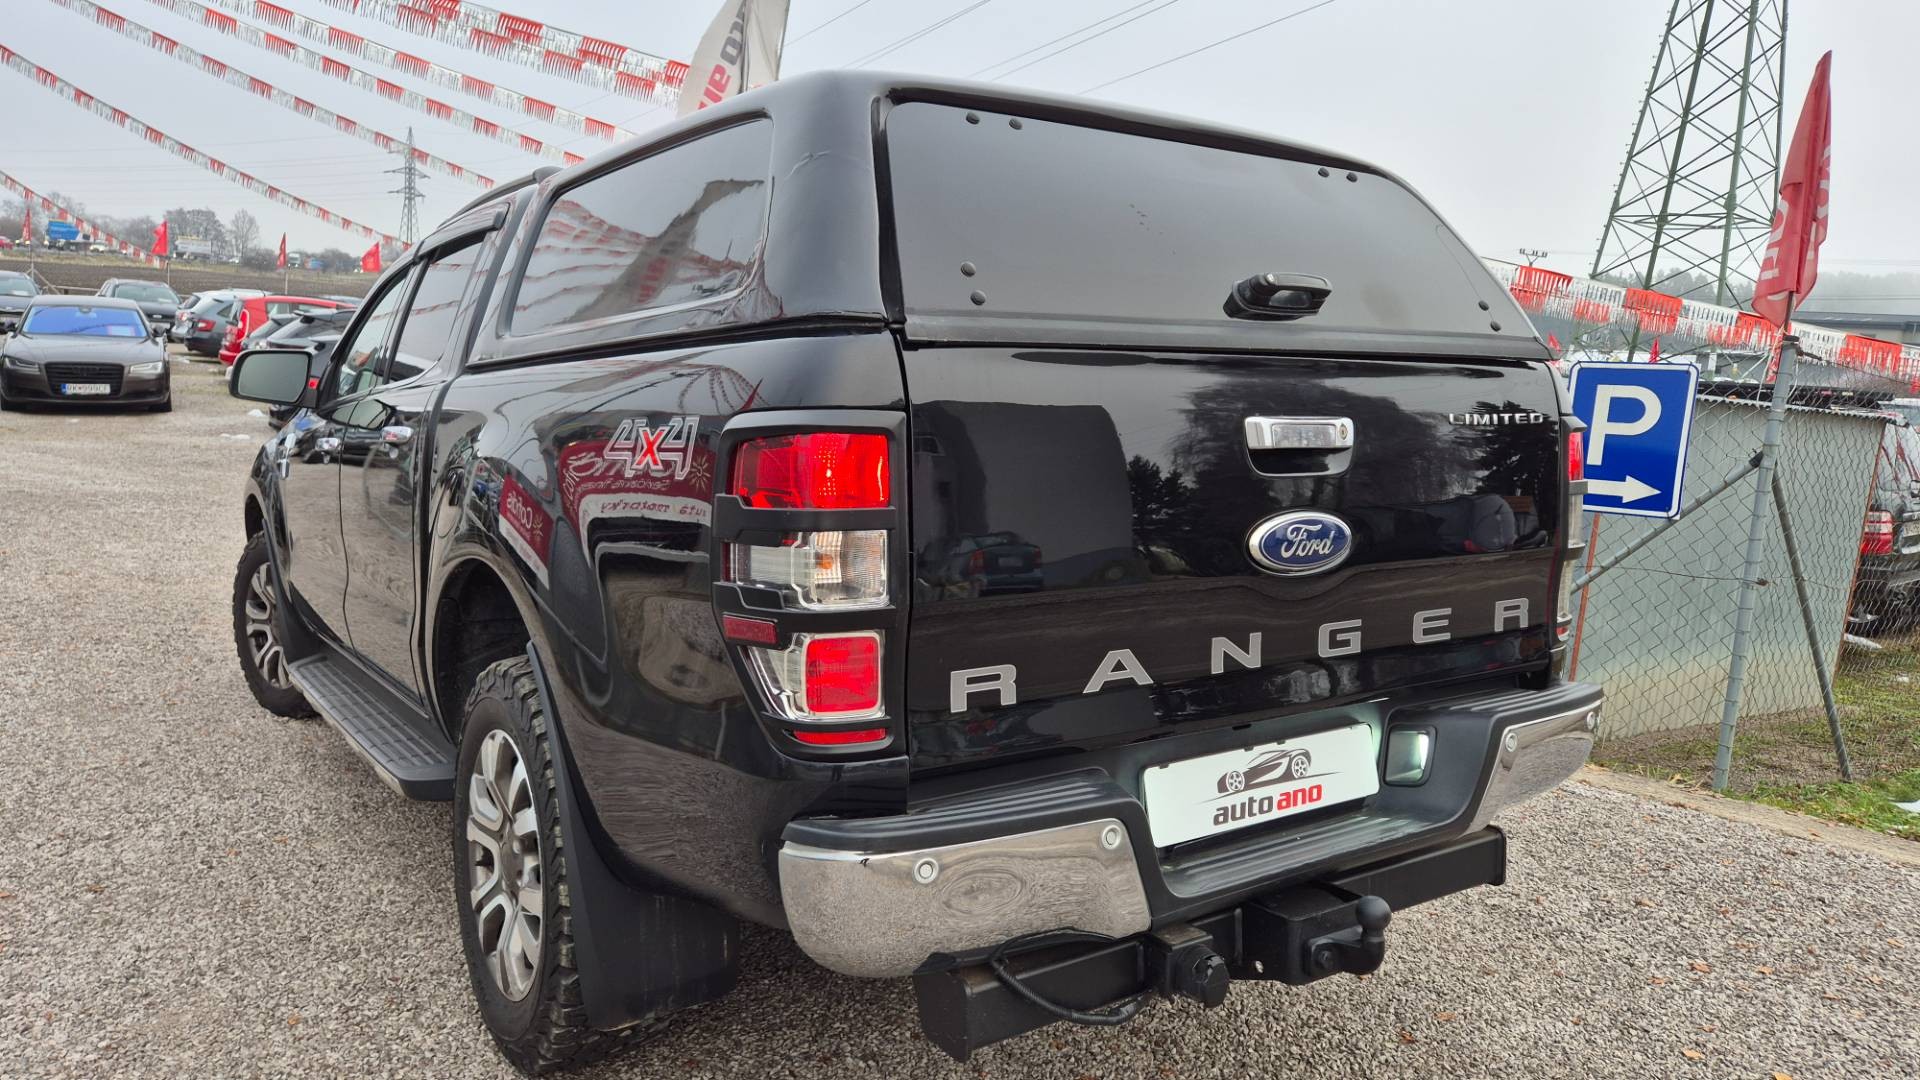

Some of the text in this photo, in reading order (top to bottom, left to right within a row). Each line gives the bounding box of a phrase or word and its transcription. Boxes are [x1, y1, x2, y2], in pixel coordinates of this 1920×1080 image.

[1449, 412, 1544, 426] LIMITED
[1586, 384, 1662, 466] P
[1281, 523, 1335, 559] Ford
[949, 598, 1530, 713] RANGER
[1213, 784, 1323, 826] auto ano
